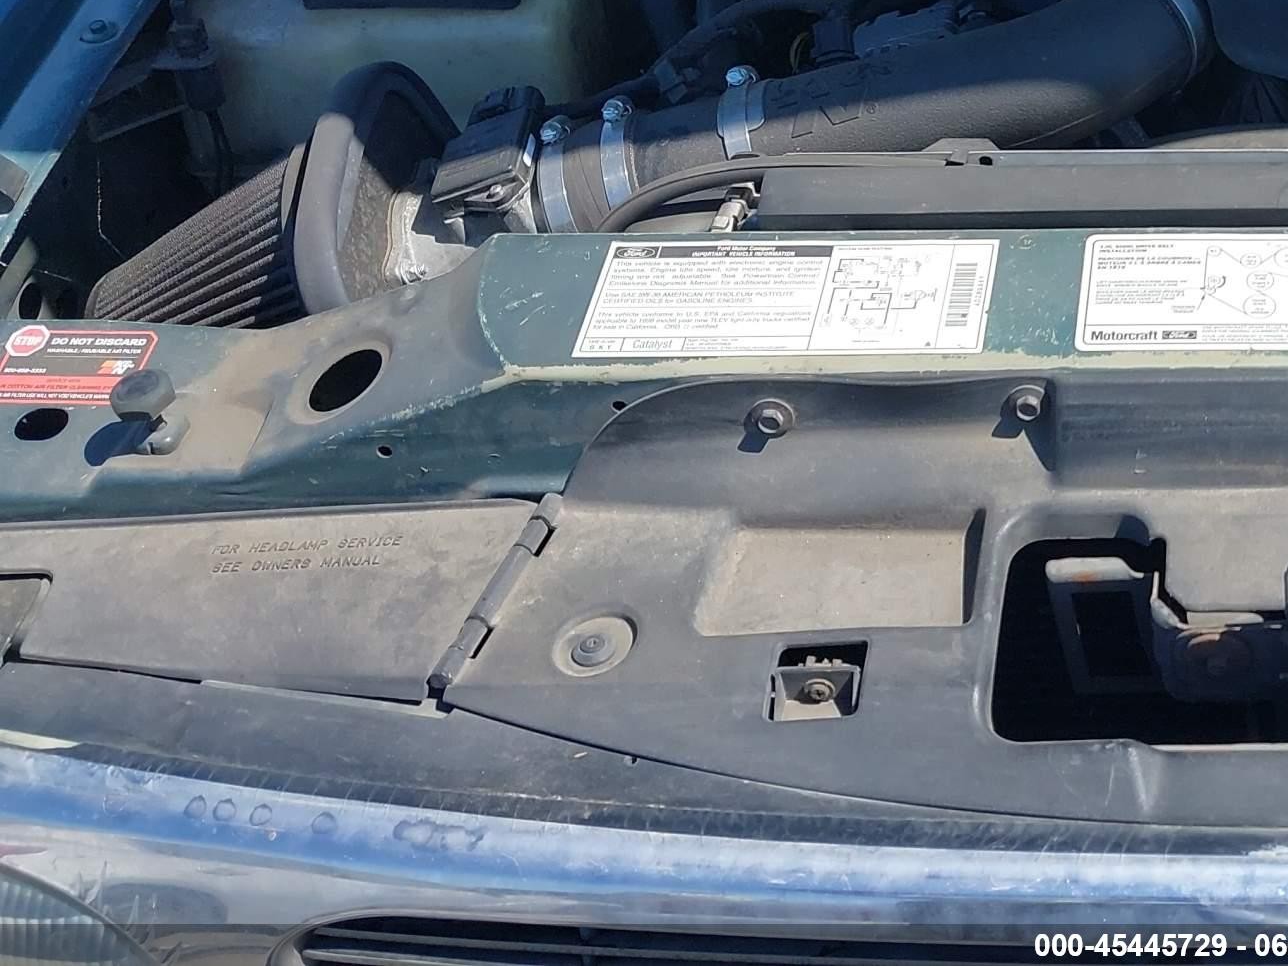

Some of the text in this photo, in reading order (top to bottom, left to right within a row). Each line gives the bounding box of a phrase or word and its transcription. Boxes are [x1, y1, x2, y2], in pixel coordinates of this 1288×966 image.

[13, 336, 43, 346] STOP
[1091, 330, 1158, 341] Motorcraft
[70, 338, 94, 346] NOT
[95, 338, 147, 347] DISCARD
[632, 339, 673, 351] Catalyst
[212, 537, 404, 554] FOR HEADLAMP SERVICE
[212, 556, 381, 572] SEE OWNERS MANUAL
